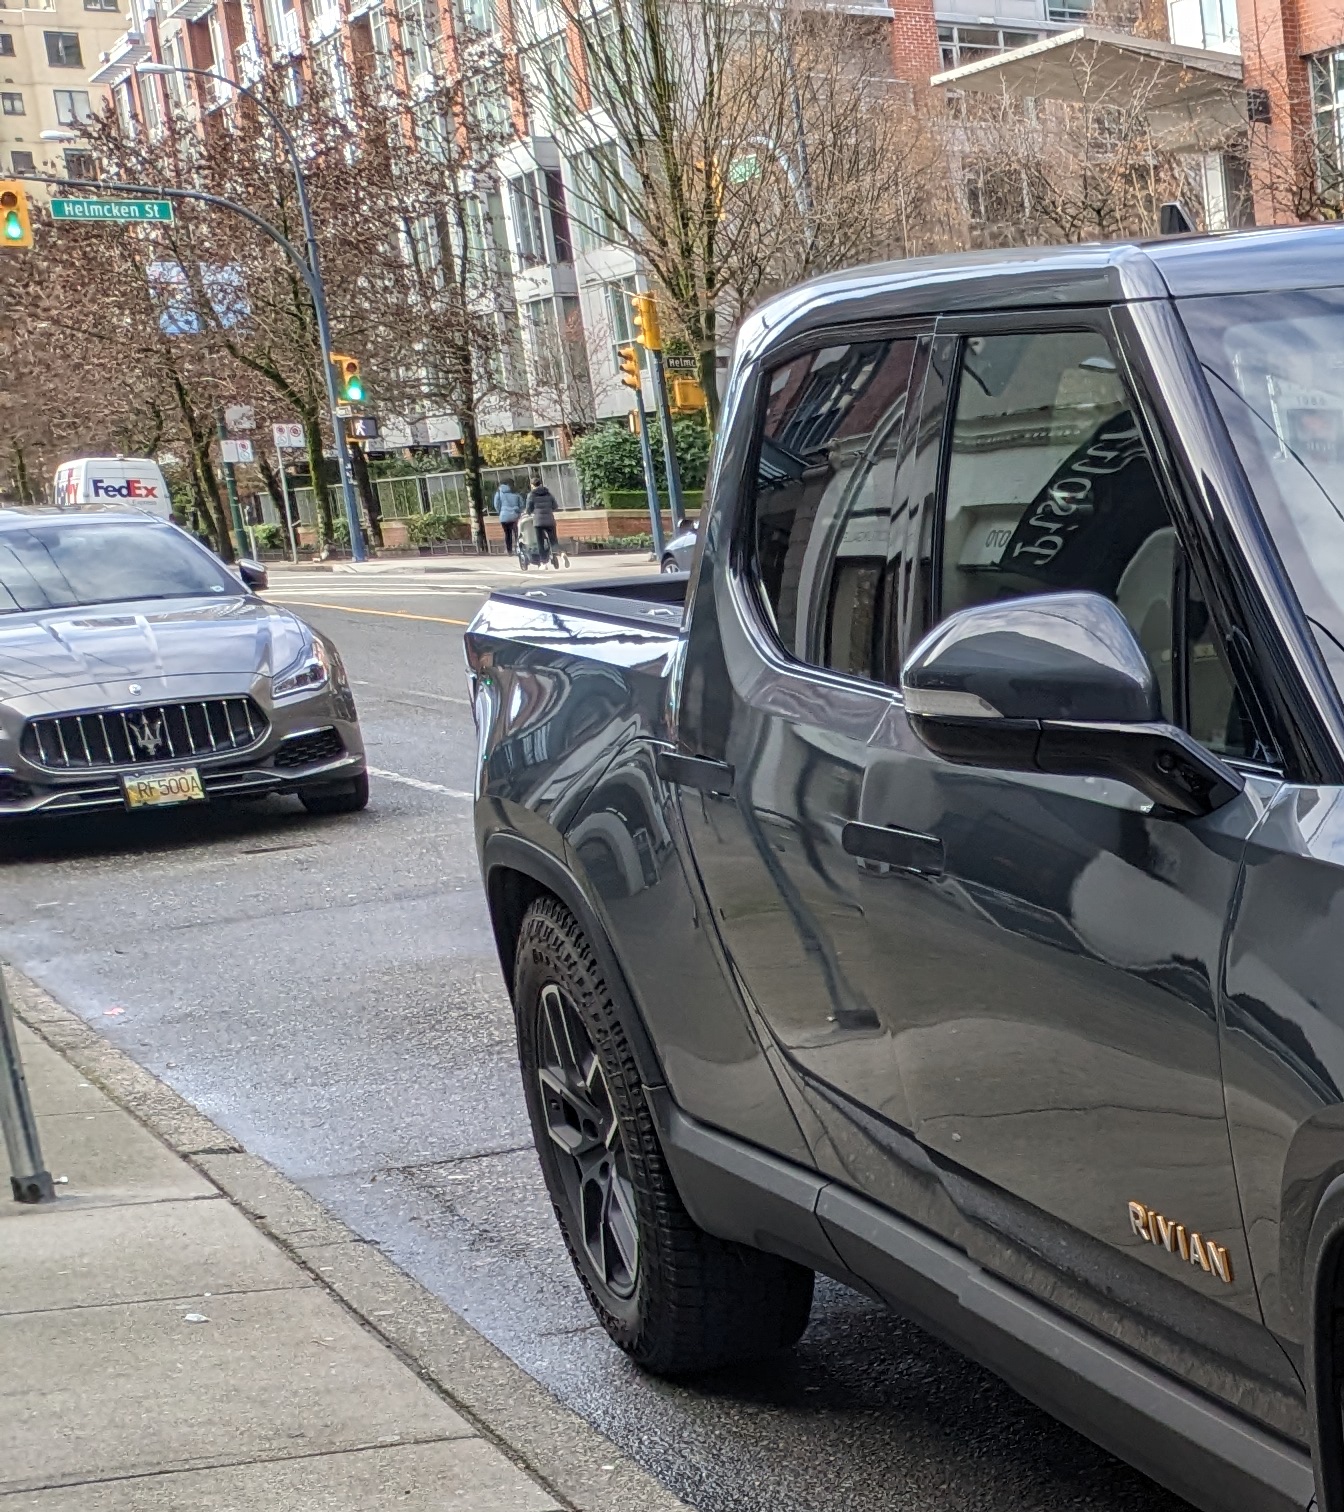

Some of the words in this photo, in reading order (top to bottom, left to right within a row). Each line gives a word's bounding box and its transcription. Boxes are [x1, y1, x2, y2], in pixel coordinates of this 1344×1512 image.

[64, 202, 139, 217] Helmcken
[145, 205, 160, 217] St
[669, 358, 695, 367] Helmc
[92, 479, 158, 498] FedEx
[1128, 1200, 1233, 1284] RIVIAN
